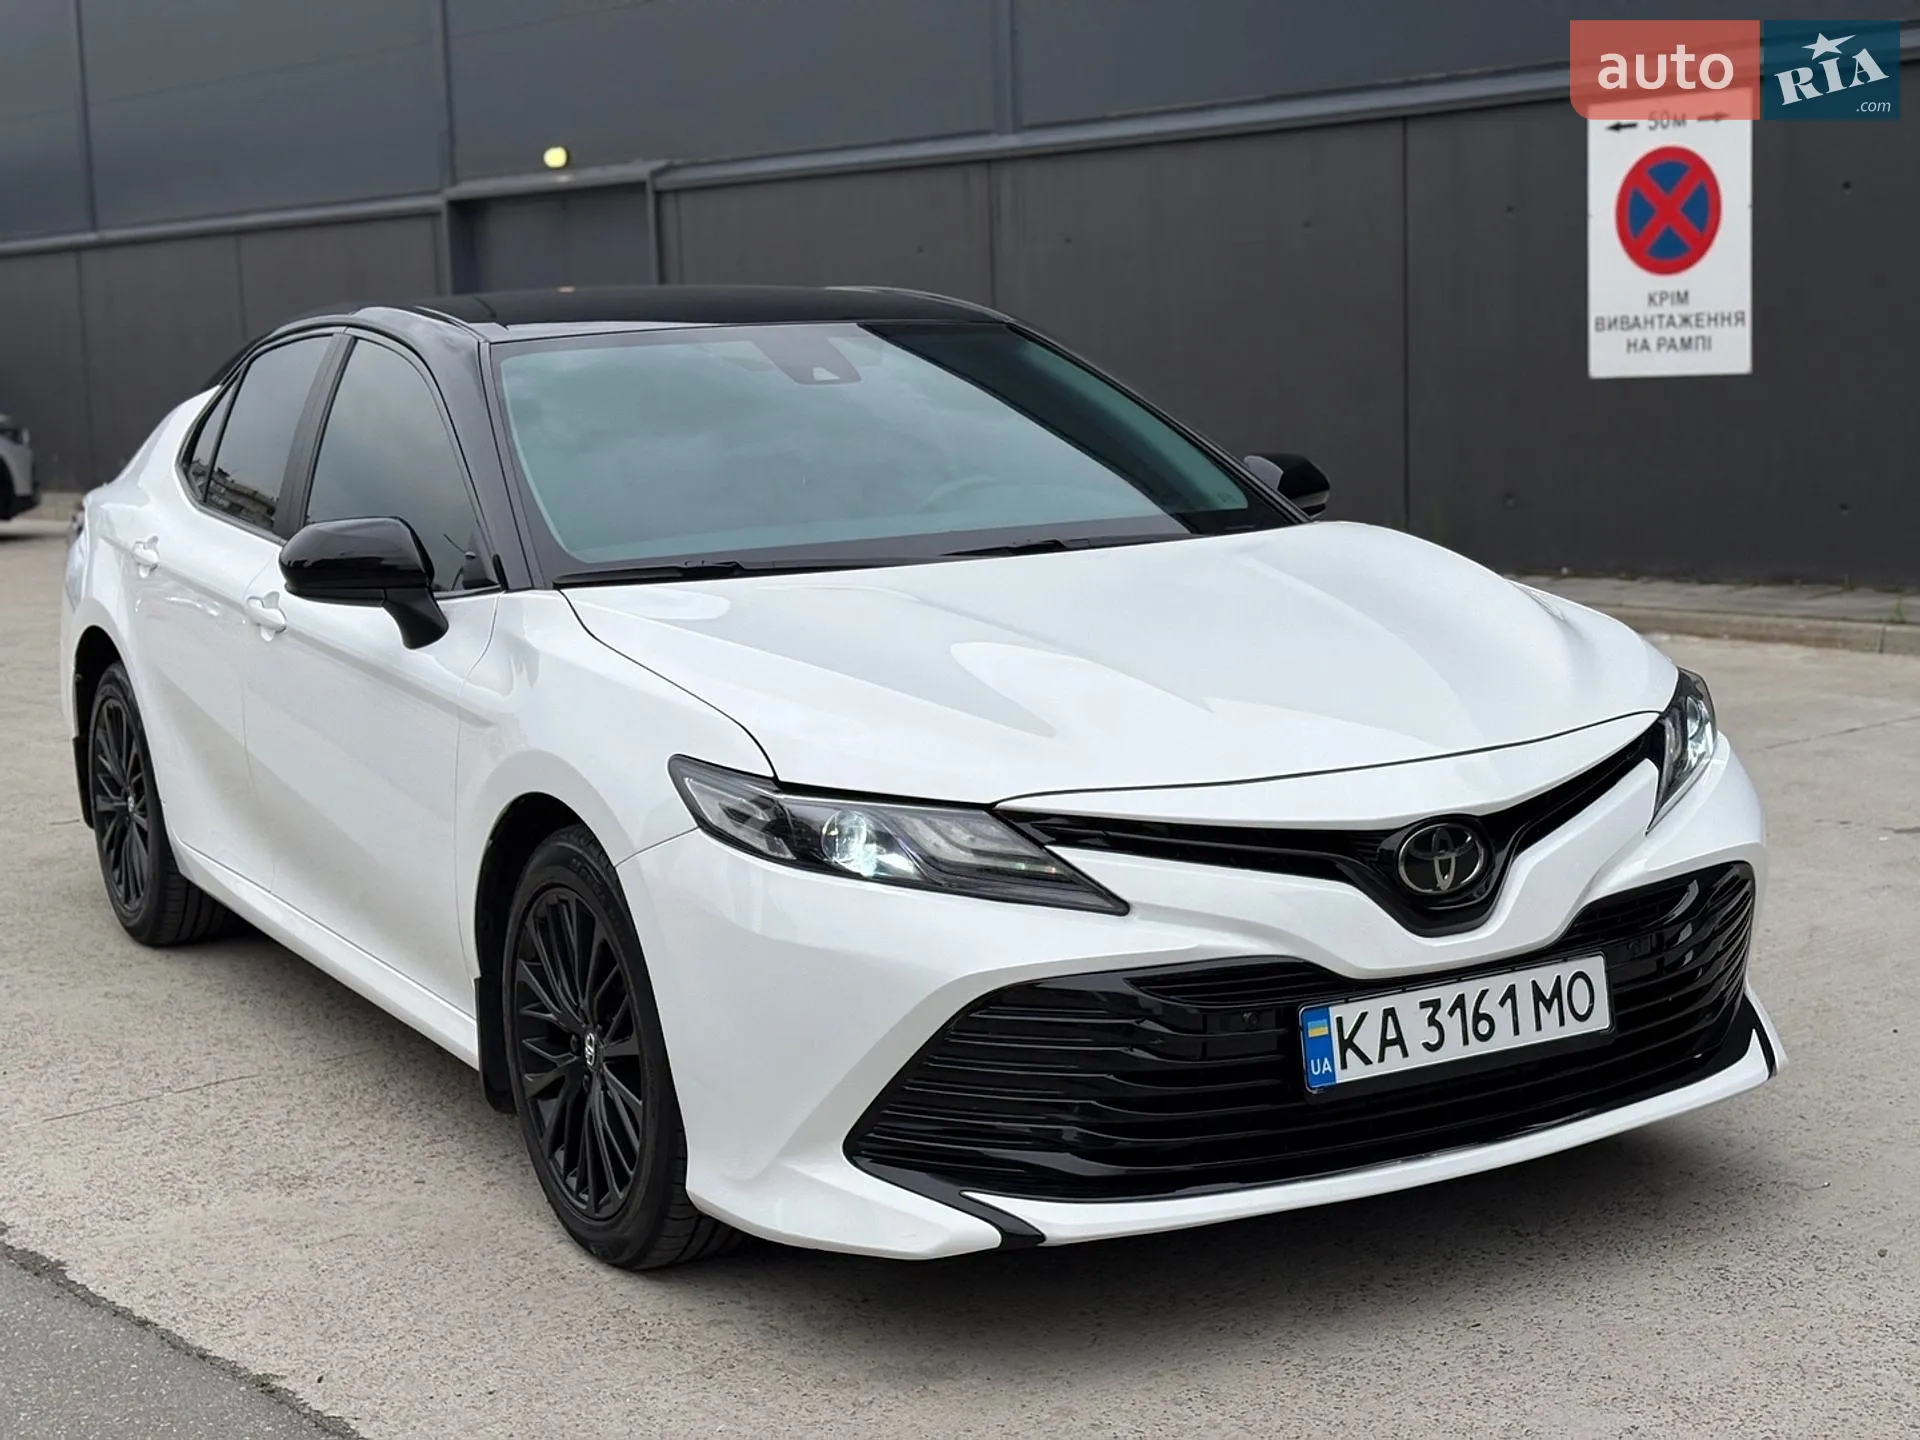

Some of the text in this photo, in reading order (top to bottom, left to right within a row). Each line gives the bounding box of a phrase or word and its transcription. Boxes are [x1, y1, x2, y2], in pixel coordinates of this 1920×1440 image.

[1648, 290, 1689, 306] КРІМ
[1595, 311, 1746, 332] ВИВАНТАЖЕННЯ
[1626, 336, 1712, 354] НА РАМПІ
[1336, 971, 1595, 1070] KA 3161 MO
[1311, 1057, 1332, 1076] UA
